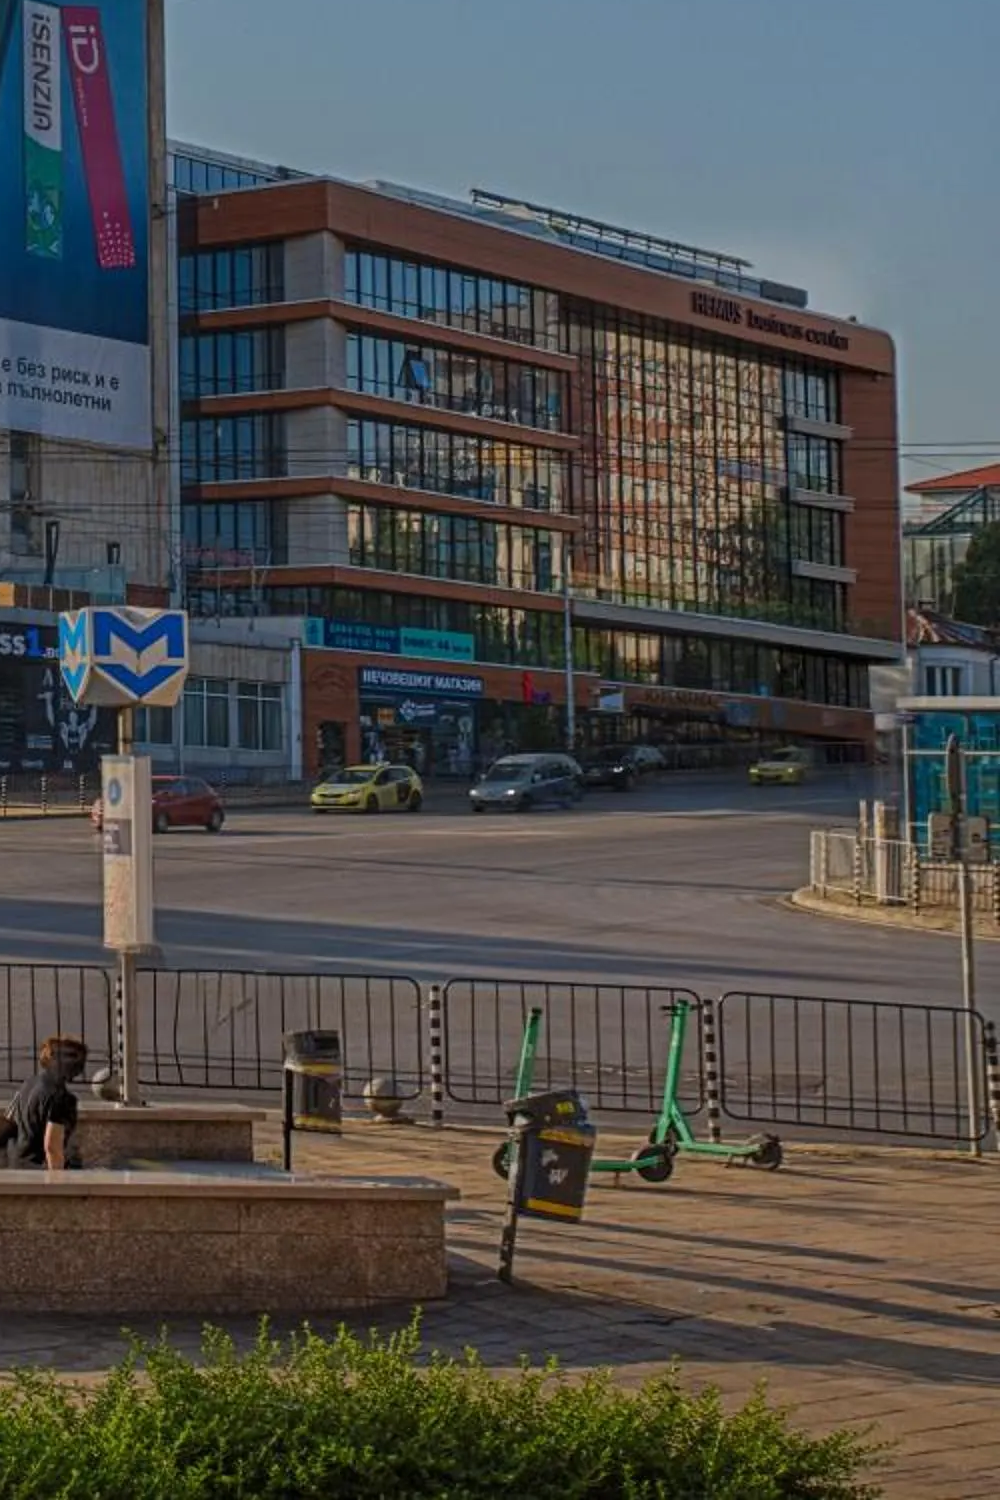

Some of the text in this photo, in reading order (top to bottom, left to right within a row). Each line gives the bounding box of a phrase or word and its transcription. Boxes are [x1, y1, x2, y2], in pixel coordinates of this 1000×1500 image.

[691, 290, 741, 325] HEMUS
[746, 308, 804, 340] business
[17, 357, 47, 378] без
[51, 364, 90, 386] риск
[7, 380, 113, 413] пълнолетни
